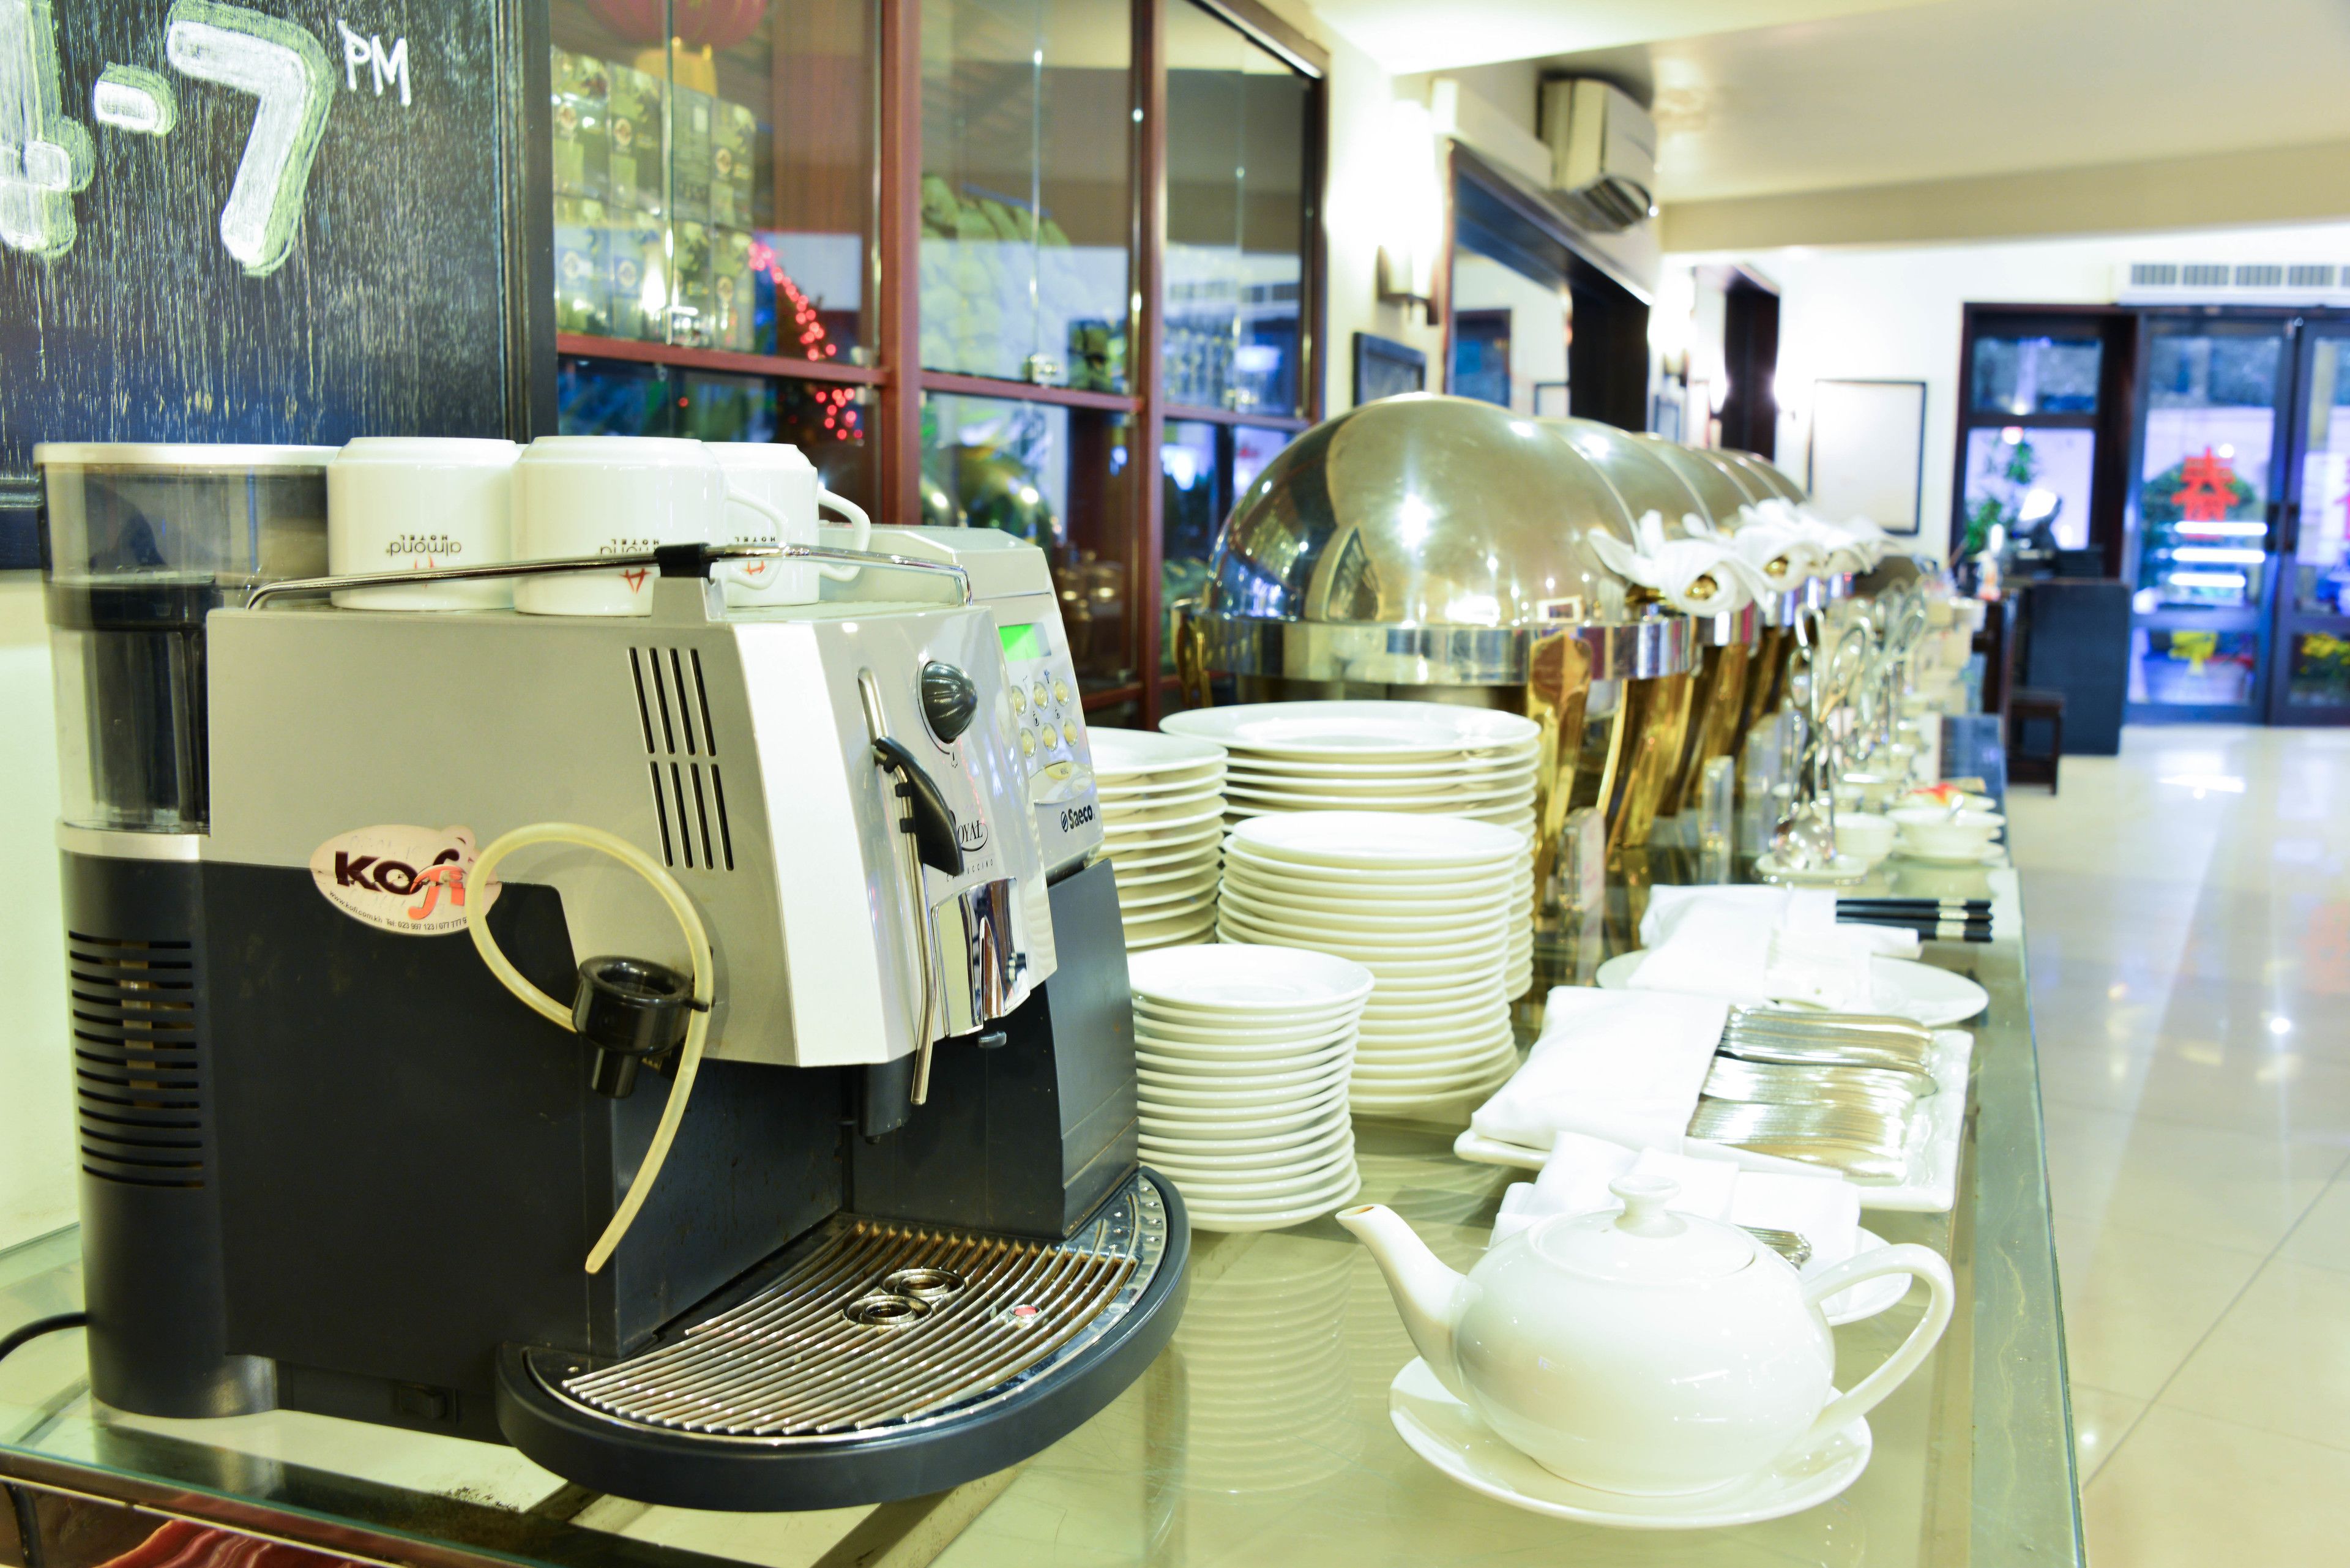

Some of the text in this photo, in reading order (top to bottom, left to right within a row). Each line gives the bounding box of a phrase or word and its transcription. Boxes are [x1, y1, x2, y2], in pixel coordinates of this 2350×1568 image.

[337, 19, 412, 107] PM
[390, 541, 462, 557] almond
[1068, 805, 1094, 829] Saeco
[947, 859, 993, 882] CUCCINO
